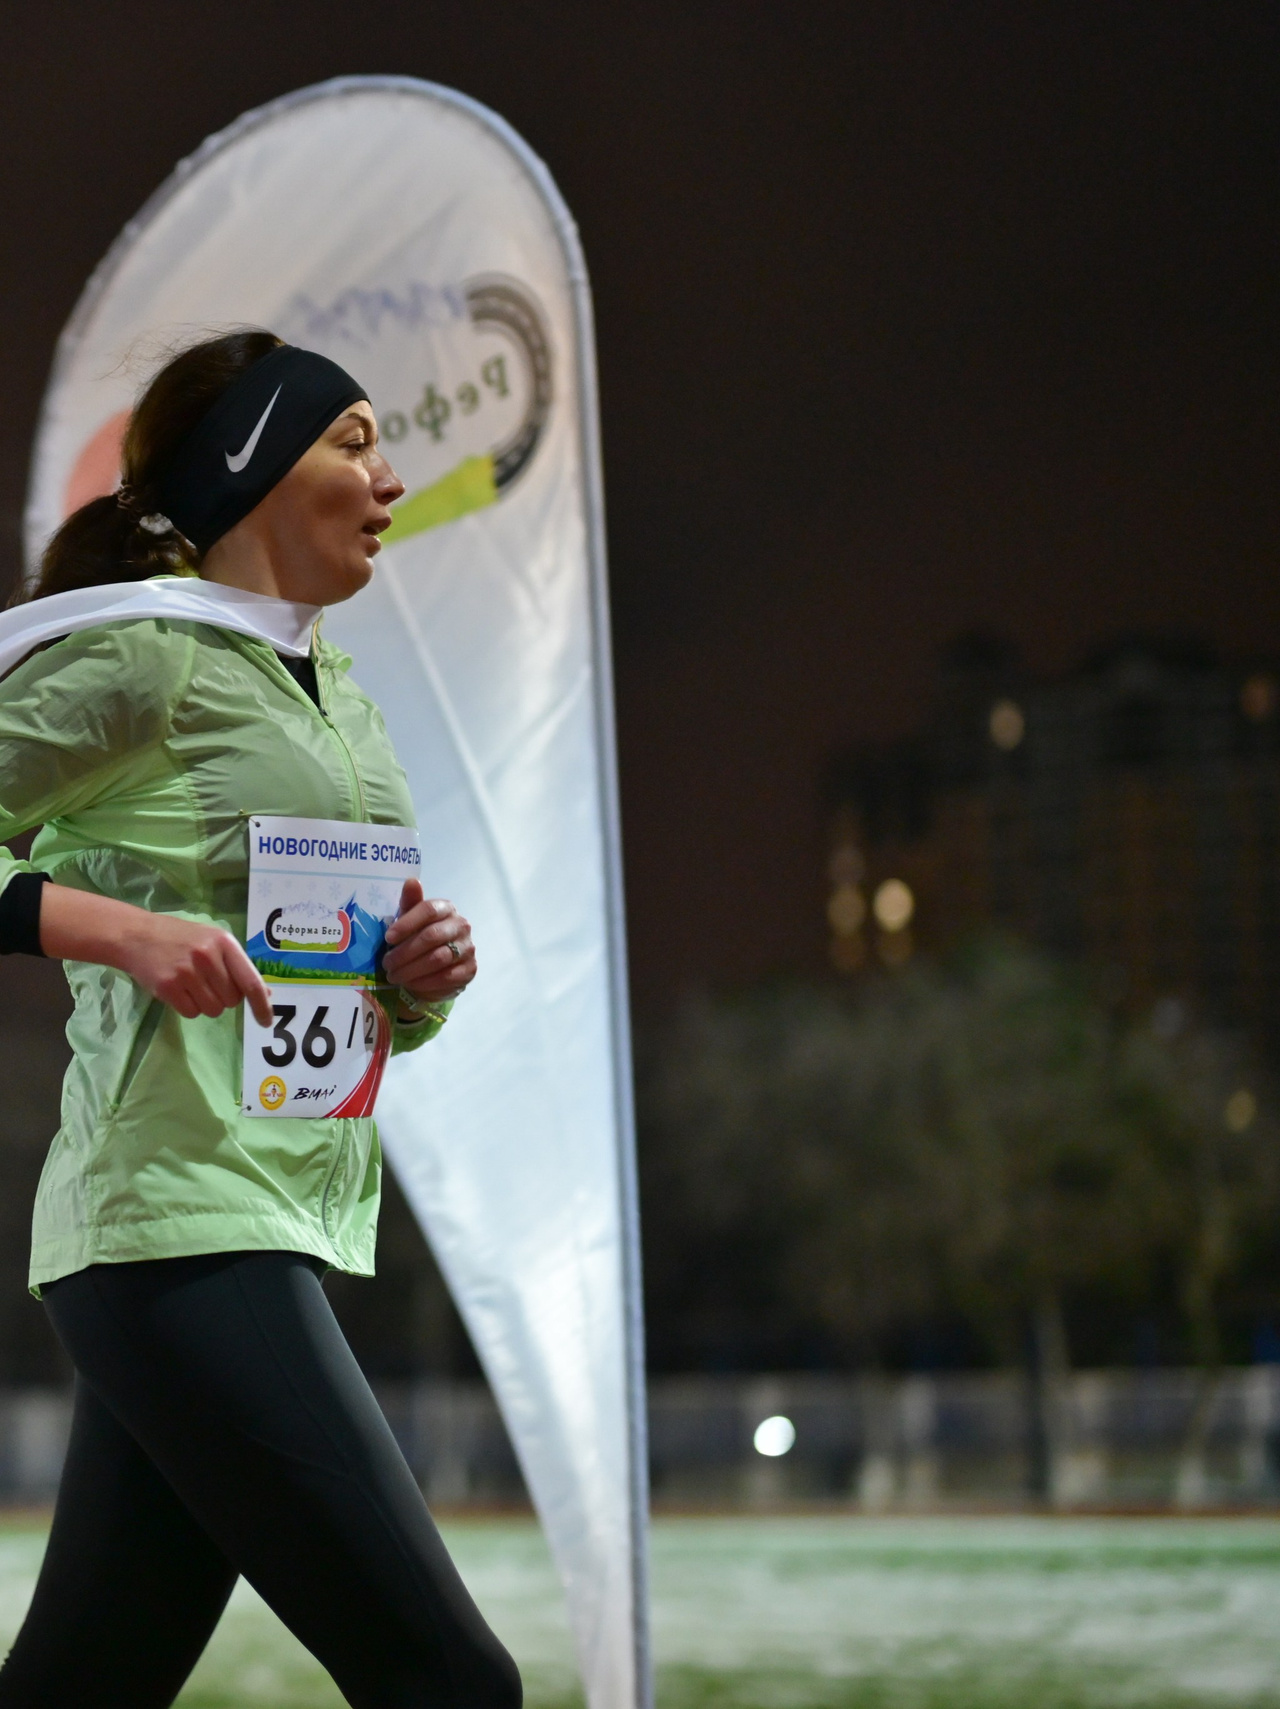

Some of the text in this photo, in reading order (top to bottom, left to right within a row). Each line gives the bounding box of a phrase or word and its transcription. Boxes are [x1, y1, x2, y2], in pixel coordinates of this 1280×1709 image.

[258, 836, 368, 862] НОВОГОДНИЕ
[275, 924, 342, 937] Реформа Бега
